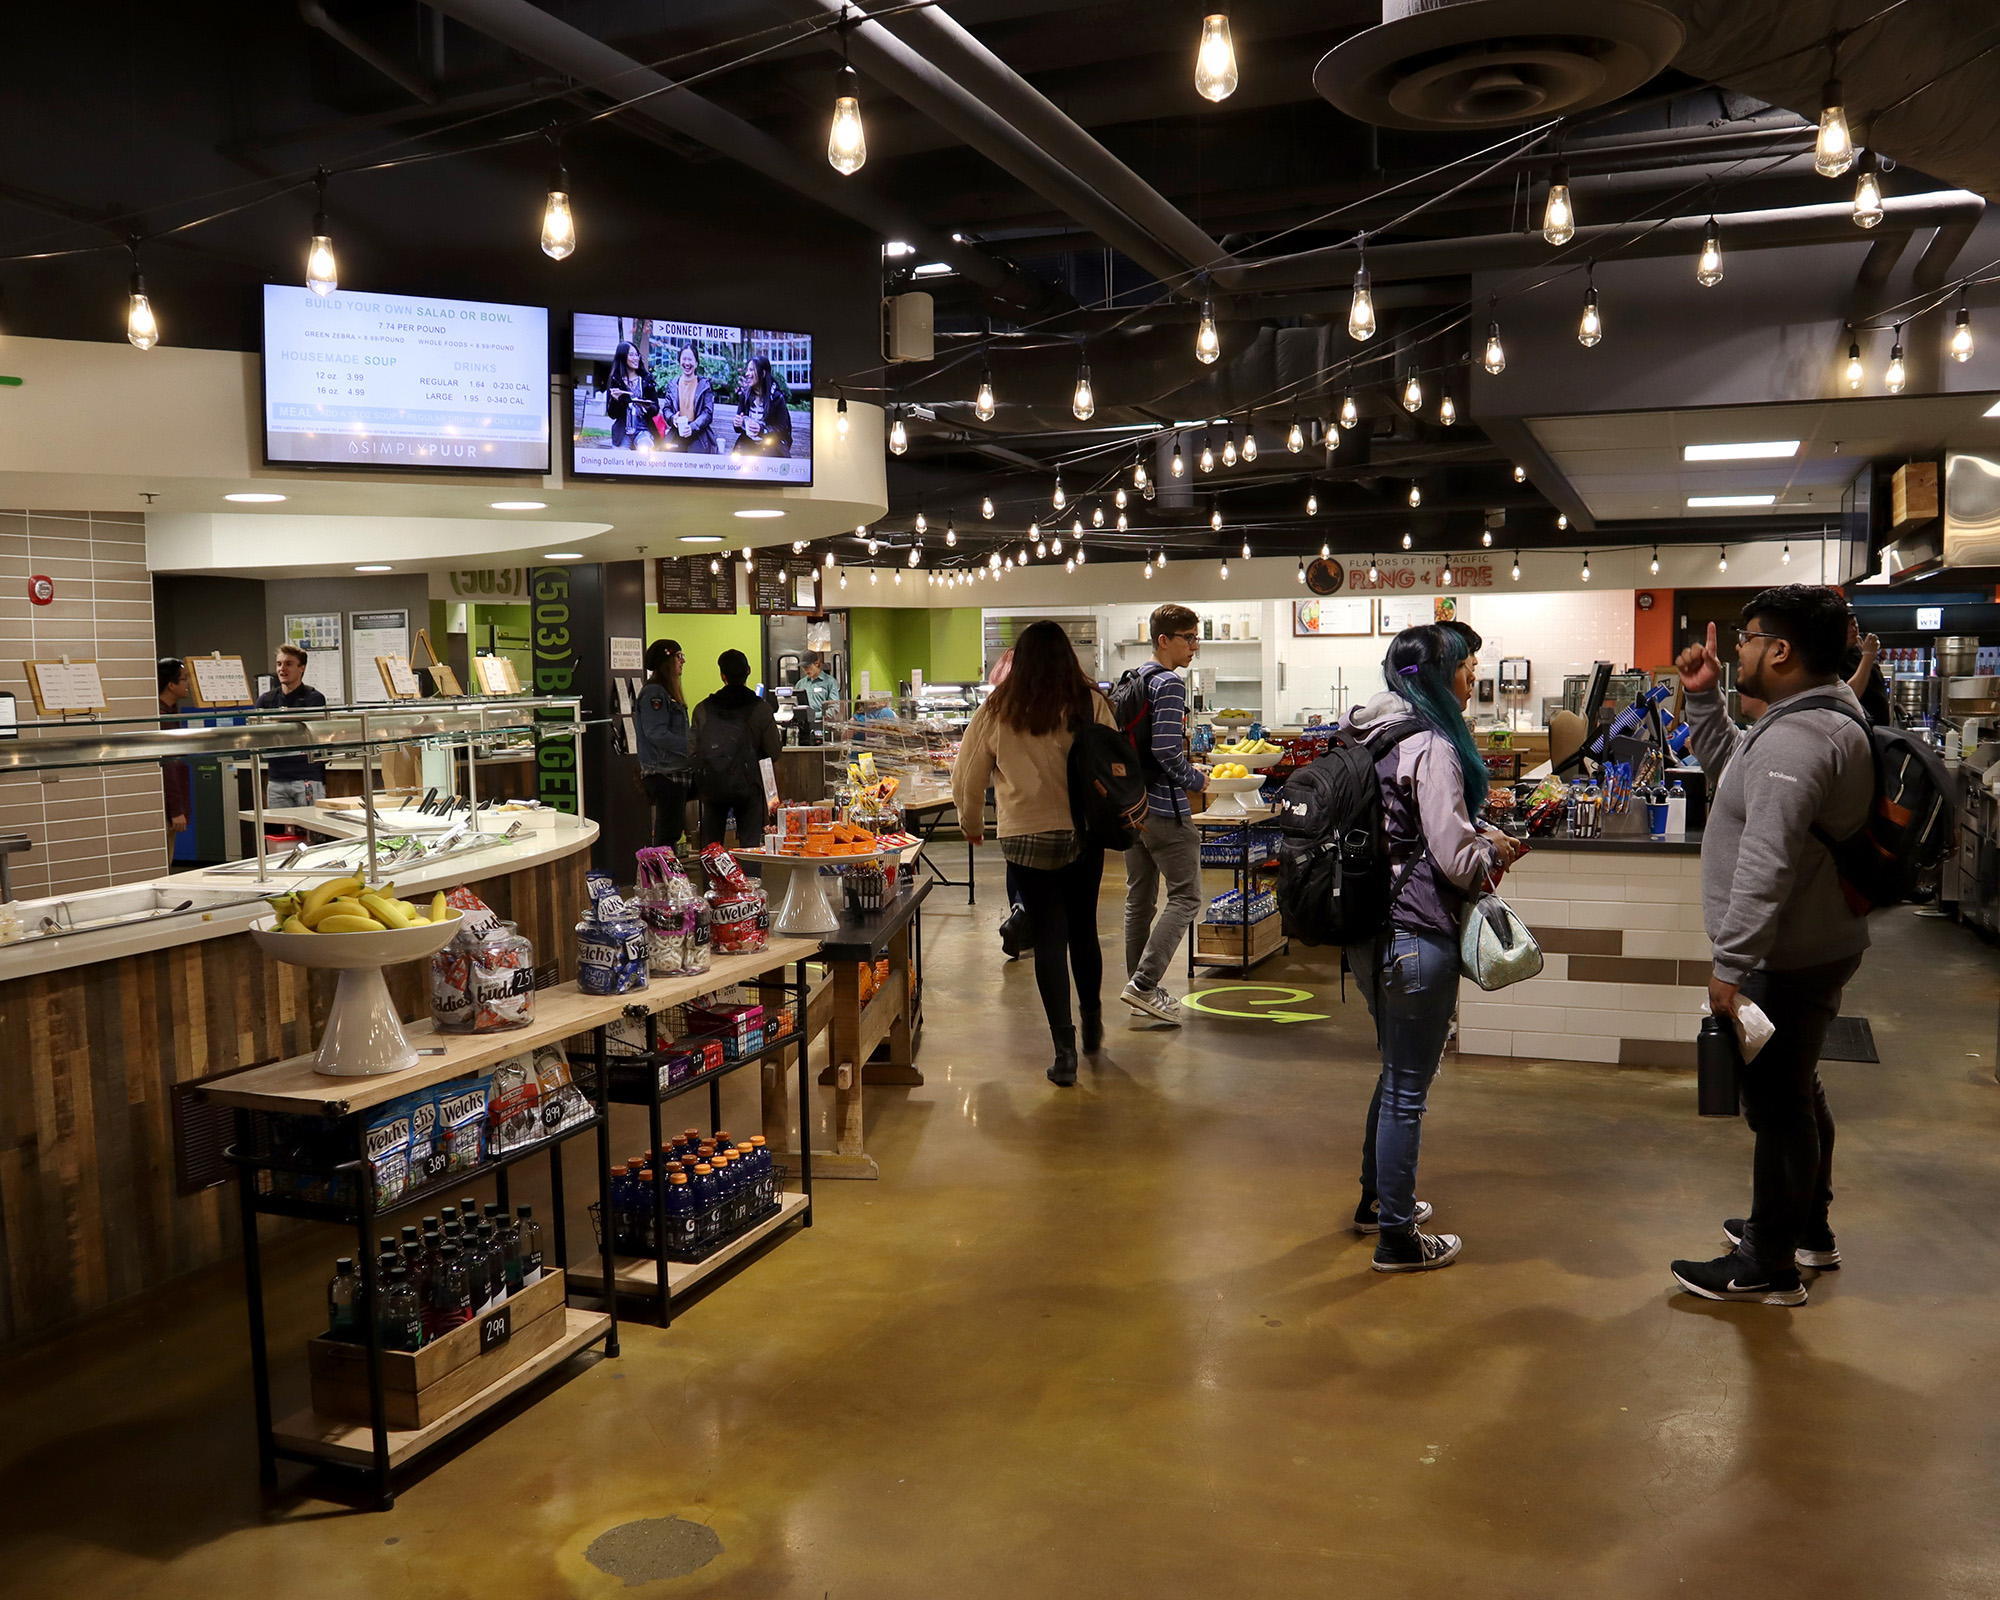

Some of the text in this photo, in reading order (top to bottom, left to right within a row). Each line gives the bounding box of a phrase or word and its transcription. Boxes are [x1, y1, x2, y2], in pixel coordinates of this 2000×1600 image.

[305, 297, 513, 324] BUILD YOUR OWN SALAD OR BOWL
[304, 330, 330, 338] GREEN
[378, 322, 446, 334] 7.74 PER POUND
[417, 338, 442, 346] WHOLE
[444, 340, 468, 348] FOODS
[281, 350, 397, 366] HOUSEMADE SOUP
[454, 361, 497, 373] DRINKS
[315, 371, 325, 380] 12
[346, 373, 364, 381] 3.99
[419, 377, 459, 387] REGULAR
[492, 382, 514, 390] 0-230
[515, 383, 531, 391] CAL
[317, 387, 326, 395] 16
[347, 388, 365, 396] 4.99
[425, 393, 453, 401] LARGE
[486, 395, 508, 404] 0-340
[509, 397, 524, 405] CAL
[279, 406, 313, 418] MEAL
[319, 409, 338, 418] ADD
[359, 411, 372, 419] OZ
[373, 411, 396, 420] SOUP
[407, 413, 446, 422] REGULAR
[448, 415, 473, 423] DRINK
[494, 418, 515, 426] ONLY
[580, 455, 602, 467] Dining
[603, 456, 625, 467] Dollars
[625, 458, 634, 467] let
[634, 460, 647, 468] you
[648, 459, 667, 470] spend
[667, 461, 683, 469] more
[684, 461, 698, 469] time
[698, 461, 711, 470] with
[712, 463, 726, 471] your
[766, 465, 808, 474] PSU EATS
[1402, 558, 1416, 566] OF
[1446, 555, 1489, 564] PACIFIC
[1435, 566, 1493, 588] FIRE
[534, 567, 572, 661] (503)
[1774, 771, 1798, 783] Columbia
[477, 980, 516, 1004] budd
[443, 1093, 484, 1123] Welch's
[414, 1106, 434, 1129] ch's
[685, 1219, 695, 1232] G
[530, 1251, 542, 1260] LIFE
[531, 1256, 542, 1264] WTR
[459, 1293, 470, 1302] LIFE
[460, 1299, 471, 1308] WTR
[406, 1320, 419, 1329] LIFE
[407, 1325, 419, 1334] WTR
